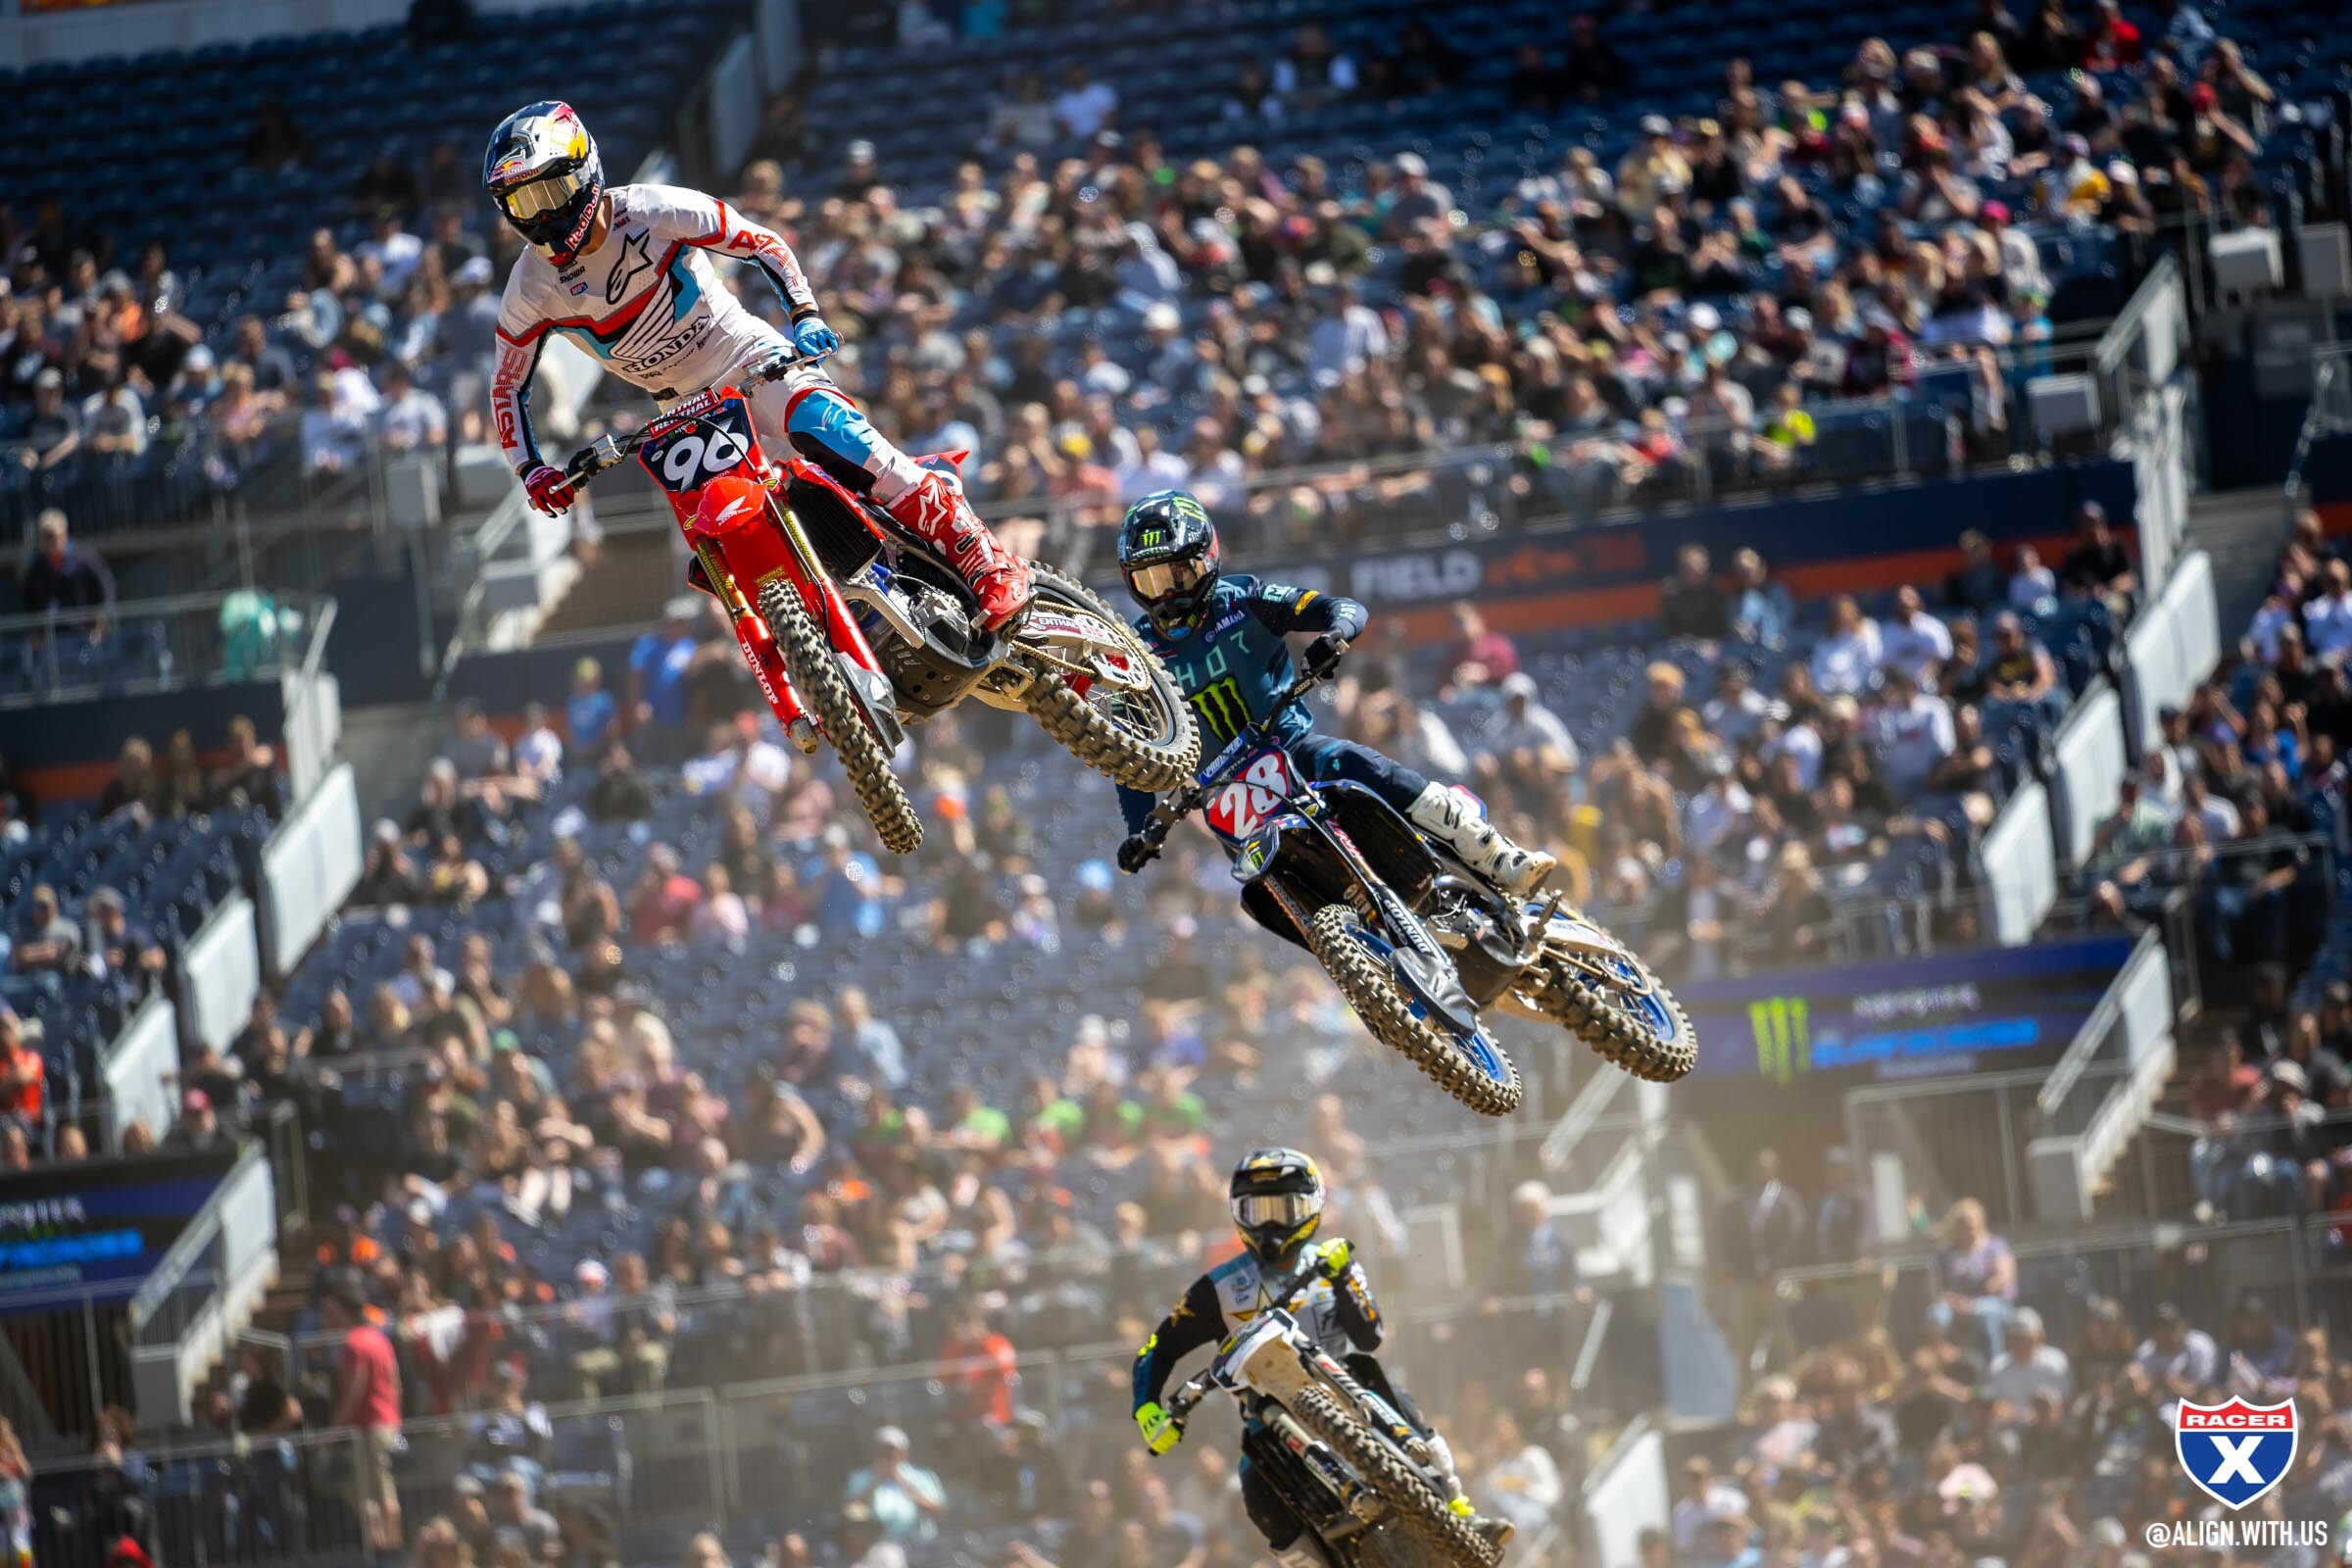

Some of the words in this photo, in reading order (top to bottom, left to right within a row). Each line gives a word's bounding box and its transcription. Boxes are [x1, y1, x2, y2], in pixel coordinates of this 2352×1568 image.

[564, 213, 589, 252] Red
[560, 266, 586, 284] SHOWA
[622, 315, 710, 372] HONDA
[652, 392, 710, 422] ENTHAL
[663, 416, 750, 495] 96
[701, 469, 730, 487] HONDA
[717, 506, 753, 526] HONDA
[1349, 551, 1482, 600] FIELD
[1214, 609, 1246, 634] YAMAHA
[742, 642, 779, 705] DUNLOP
[1175, 630, 1250, 688] HOT
[1219, 754, 1287, 840] 28
[1383, 898, 1432, 955] DUNLOP
